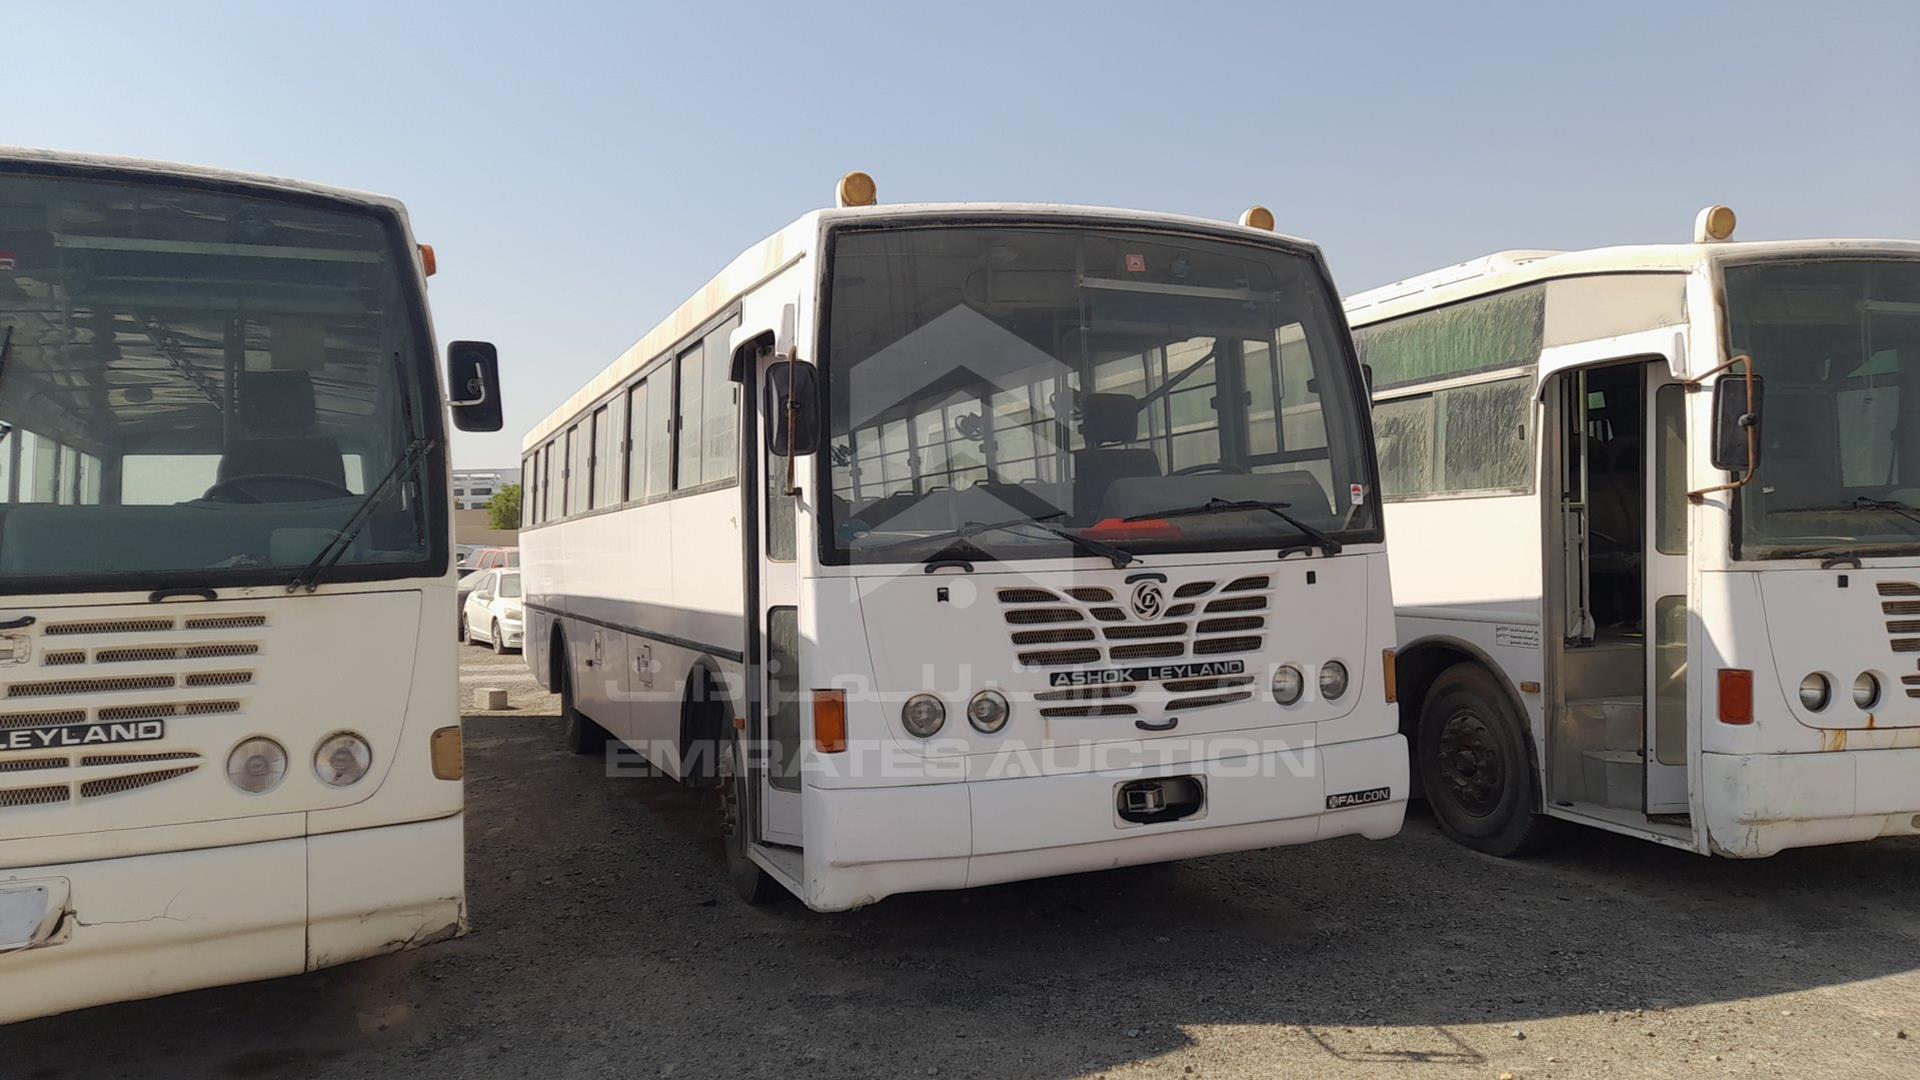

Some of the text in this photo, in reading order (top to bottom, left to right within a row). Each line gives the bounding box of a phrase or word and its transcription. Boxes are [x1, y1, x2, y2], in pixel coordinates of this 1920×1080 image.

[1054, 660, 1243, 686] ASHOK LEYLAND
[1339, 788, 1389, 806] FALCON
